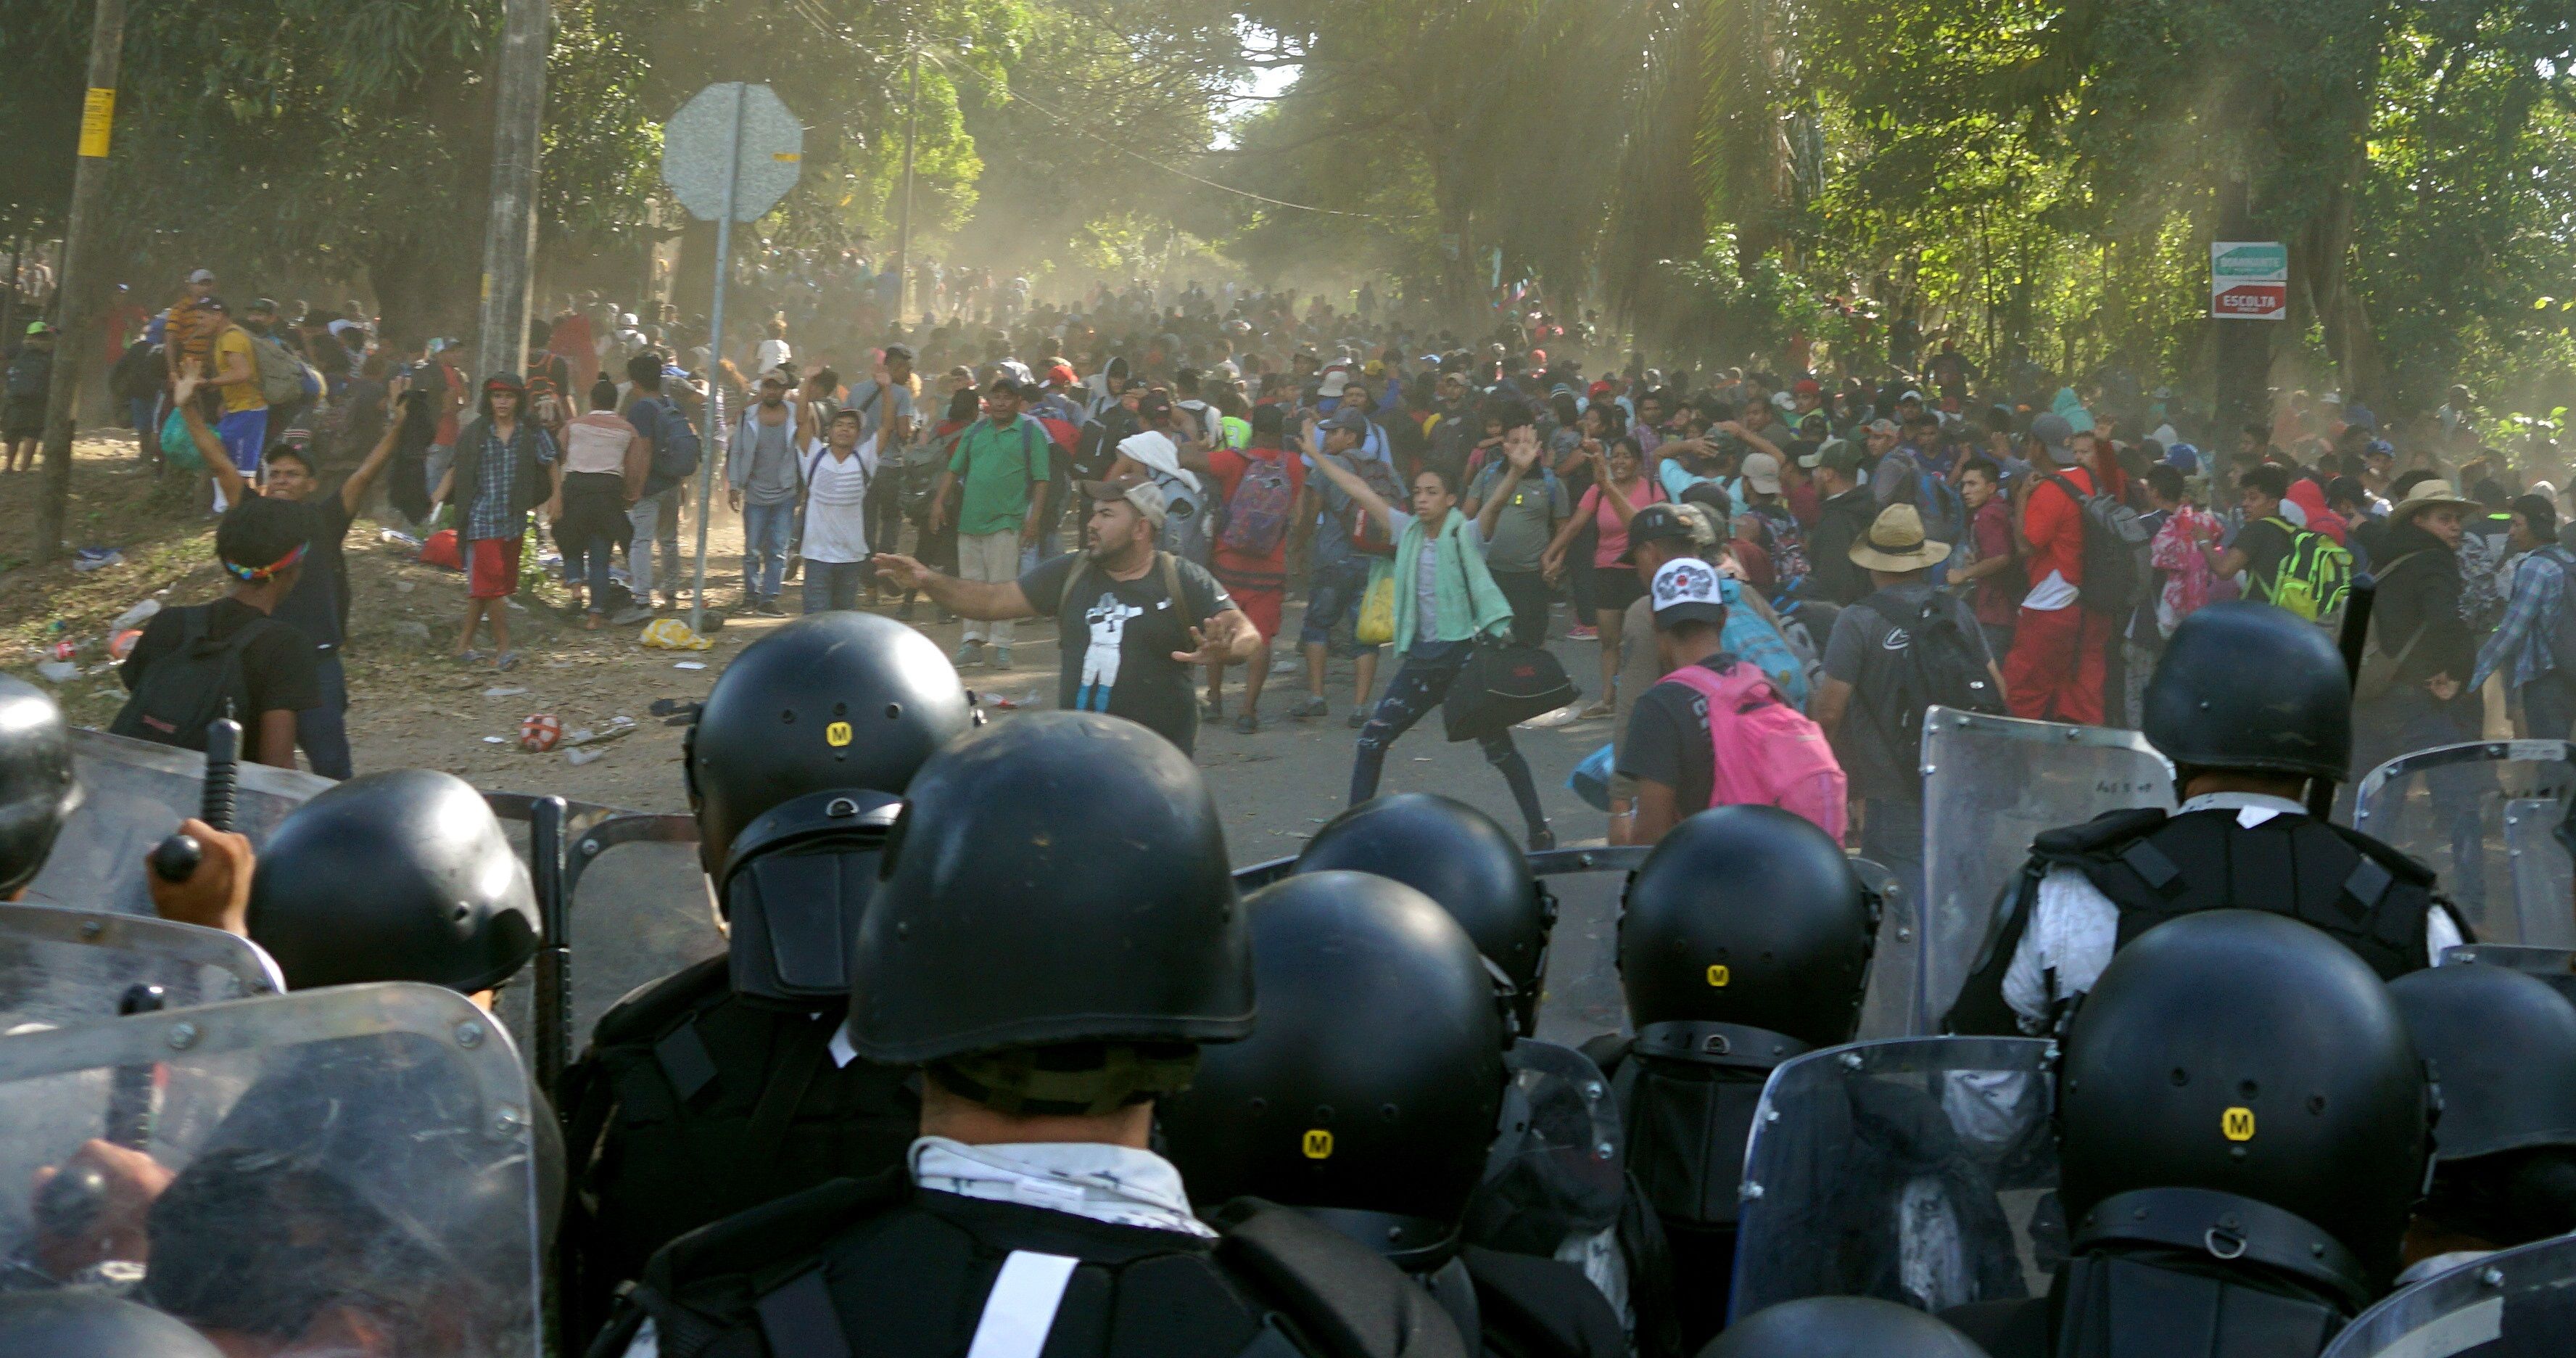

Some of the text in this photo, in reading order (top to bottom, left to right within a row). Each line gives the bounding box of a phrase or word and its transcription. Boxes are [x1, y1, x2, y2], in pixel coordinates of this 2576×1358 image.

[2224, 295, 2276, 308] ESCOLTA
[833, 726, 847, 741] M
[2230, 1114, 2249, 1133] M
[1309, 1135, 1327, 1153] M
